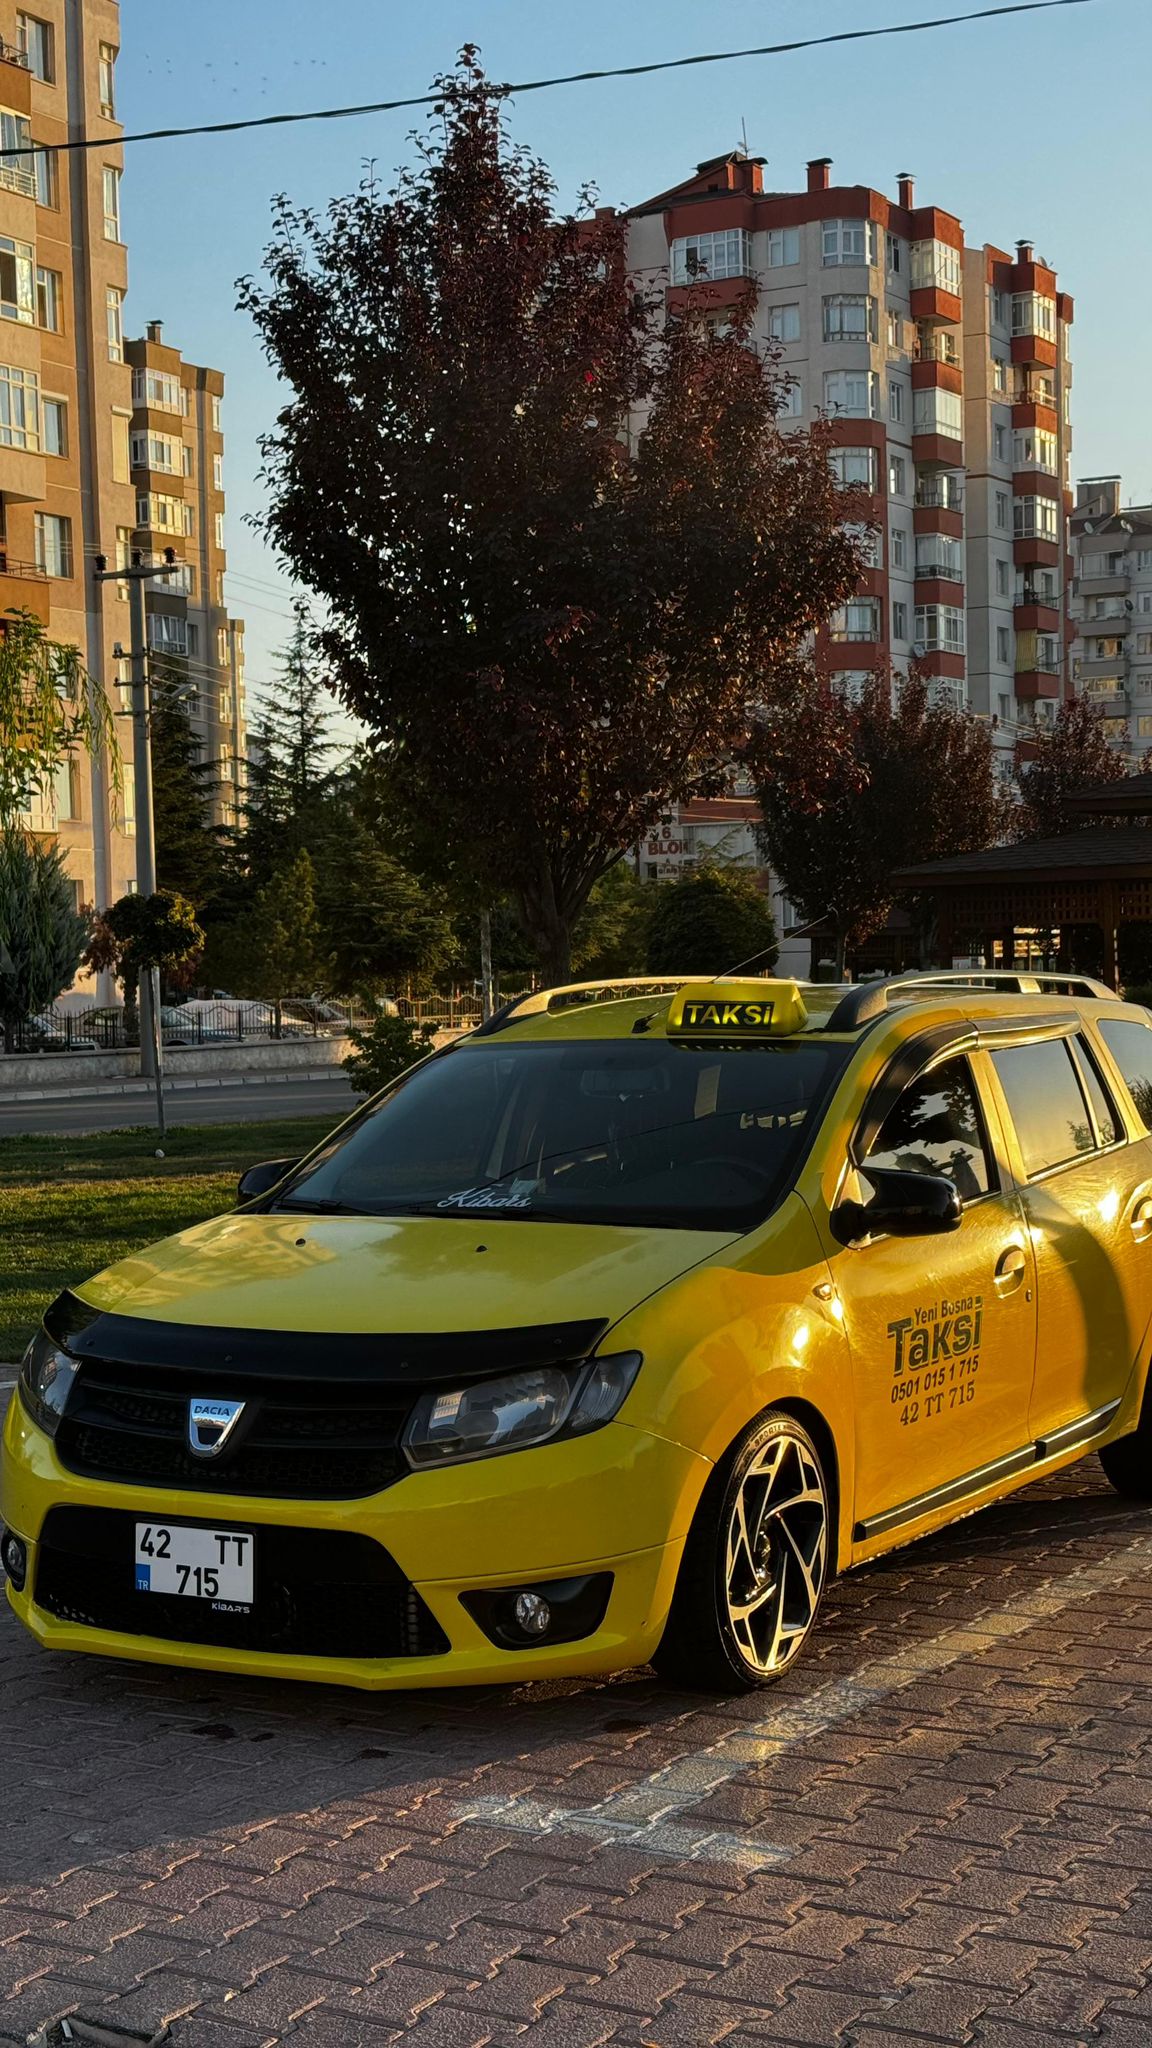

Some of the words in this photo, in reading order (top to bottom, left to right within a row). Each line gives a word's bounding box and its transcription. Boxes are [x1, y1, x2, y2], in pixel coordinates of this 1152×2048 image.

[914, 1302, 938, 1326] Yeni
[941, 1296, 973, 1318] Bosna
[887, 1295, 983, 1378] Taksi
[891, 1376, 920, 1404] 0501
[924, 1367, 946, 1391] 015
[949, 1362, 955, 1381] 1
[959, 1354, 979, 1378] 715
[194, 1405, 230, 1416] DACIA
[900, 1401, 919, 1426] 42
[924, 1392, 944, 1418] TT
[949, 1380, 975, 1409] 715
[140, 1527, 171, 1559] 42
[214, 1534, 249, 1567] TT
[137, 1579, 149, 1591] TR
[176, 1564, 219, 1598] 715
